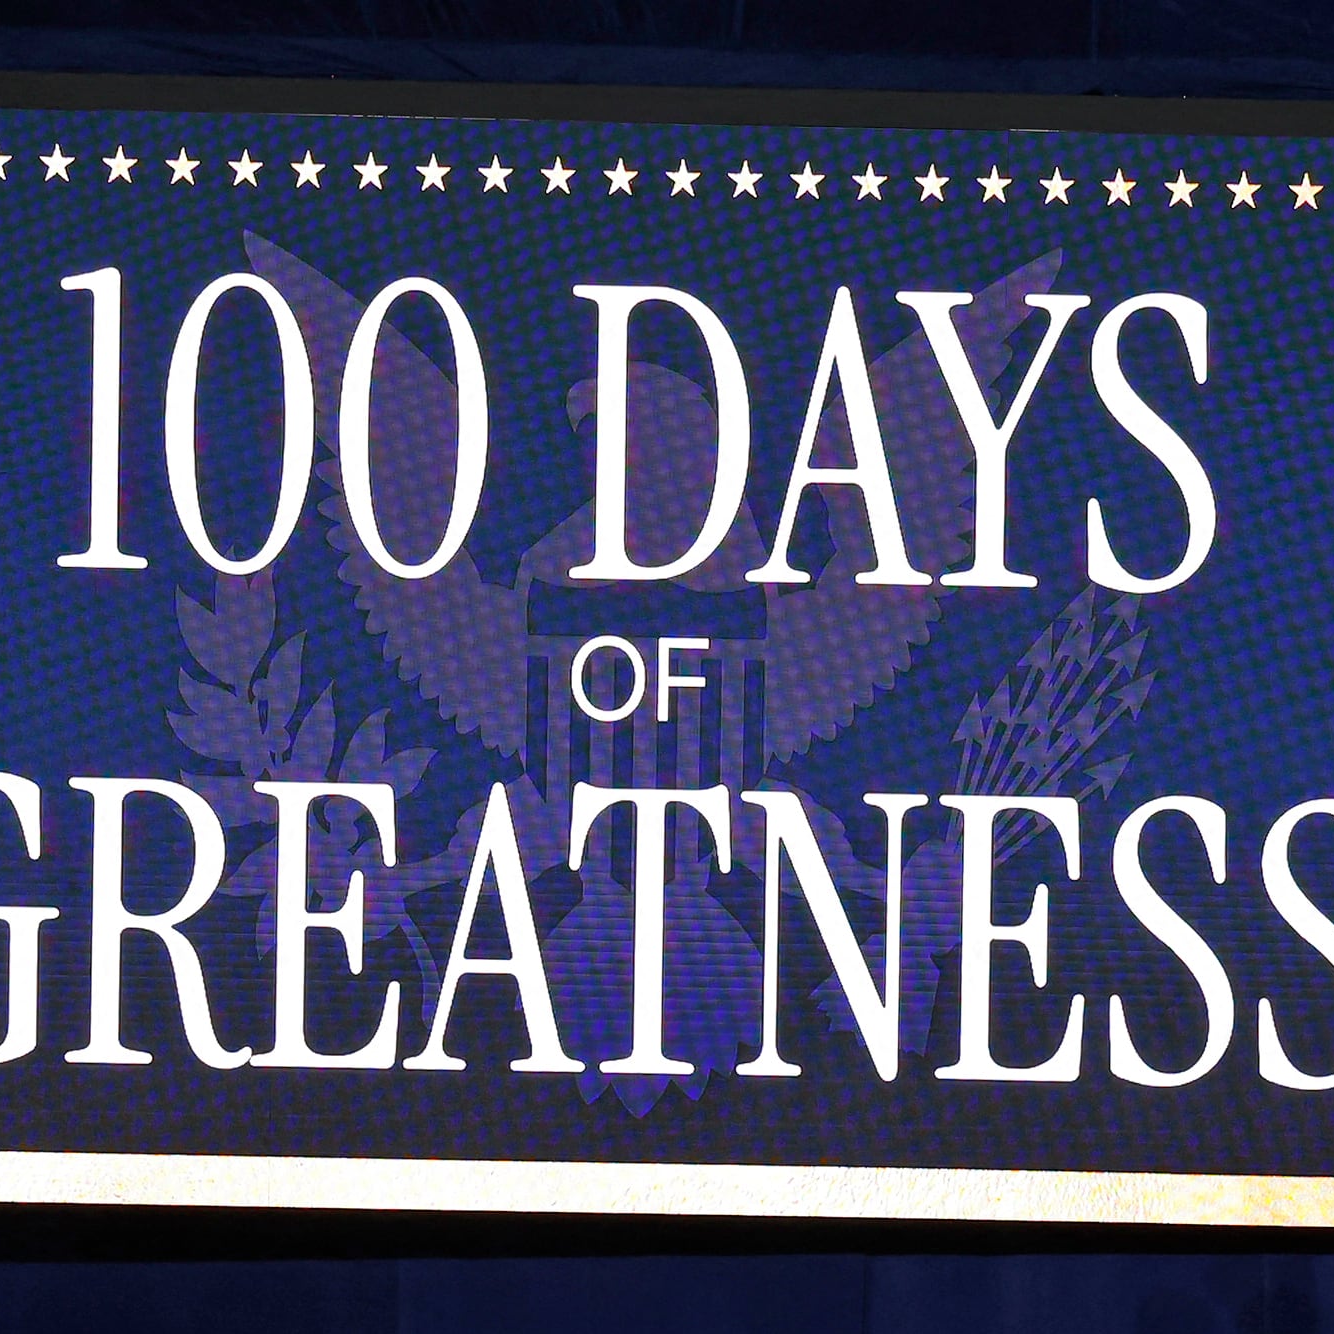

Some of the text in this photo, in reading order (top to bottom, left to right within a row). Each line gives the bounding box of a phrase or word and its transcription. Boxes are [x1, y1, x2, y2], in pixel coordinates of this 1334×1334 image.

[57, 266, 1217, 596] 100 DAYS
[570, 635, 710, 724] OF
